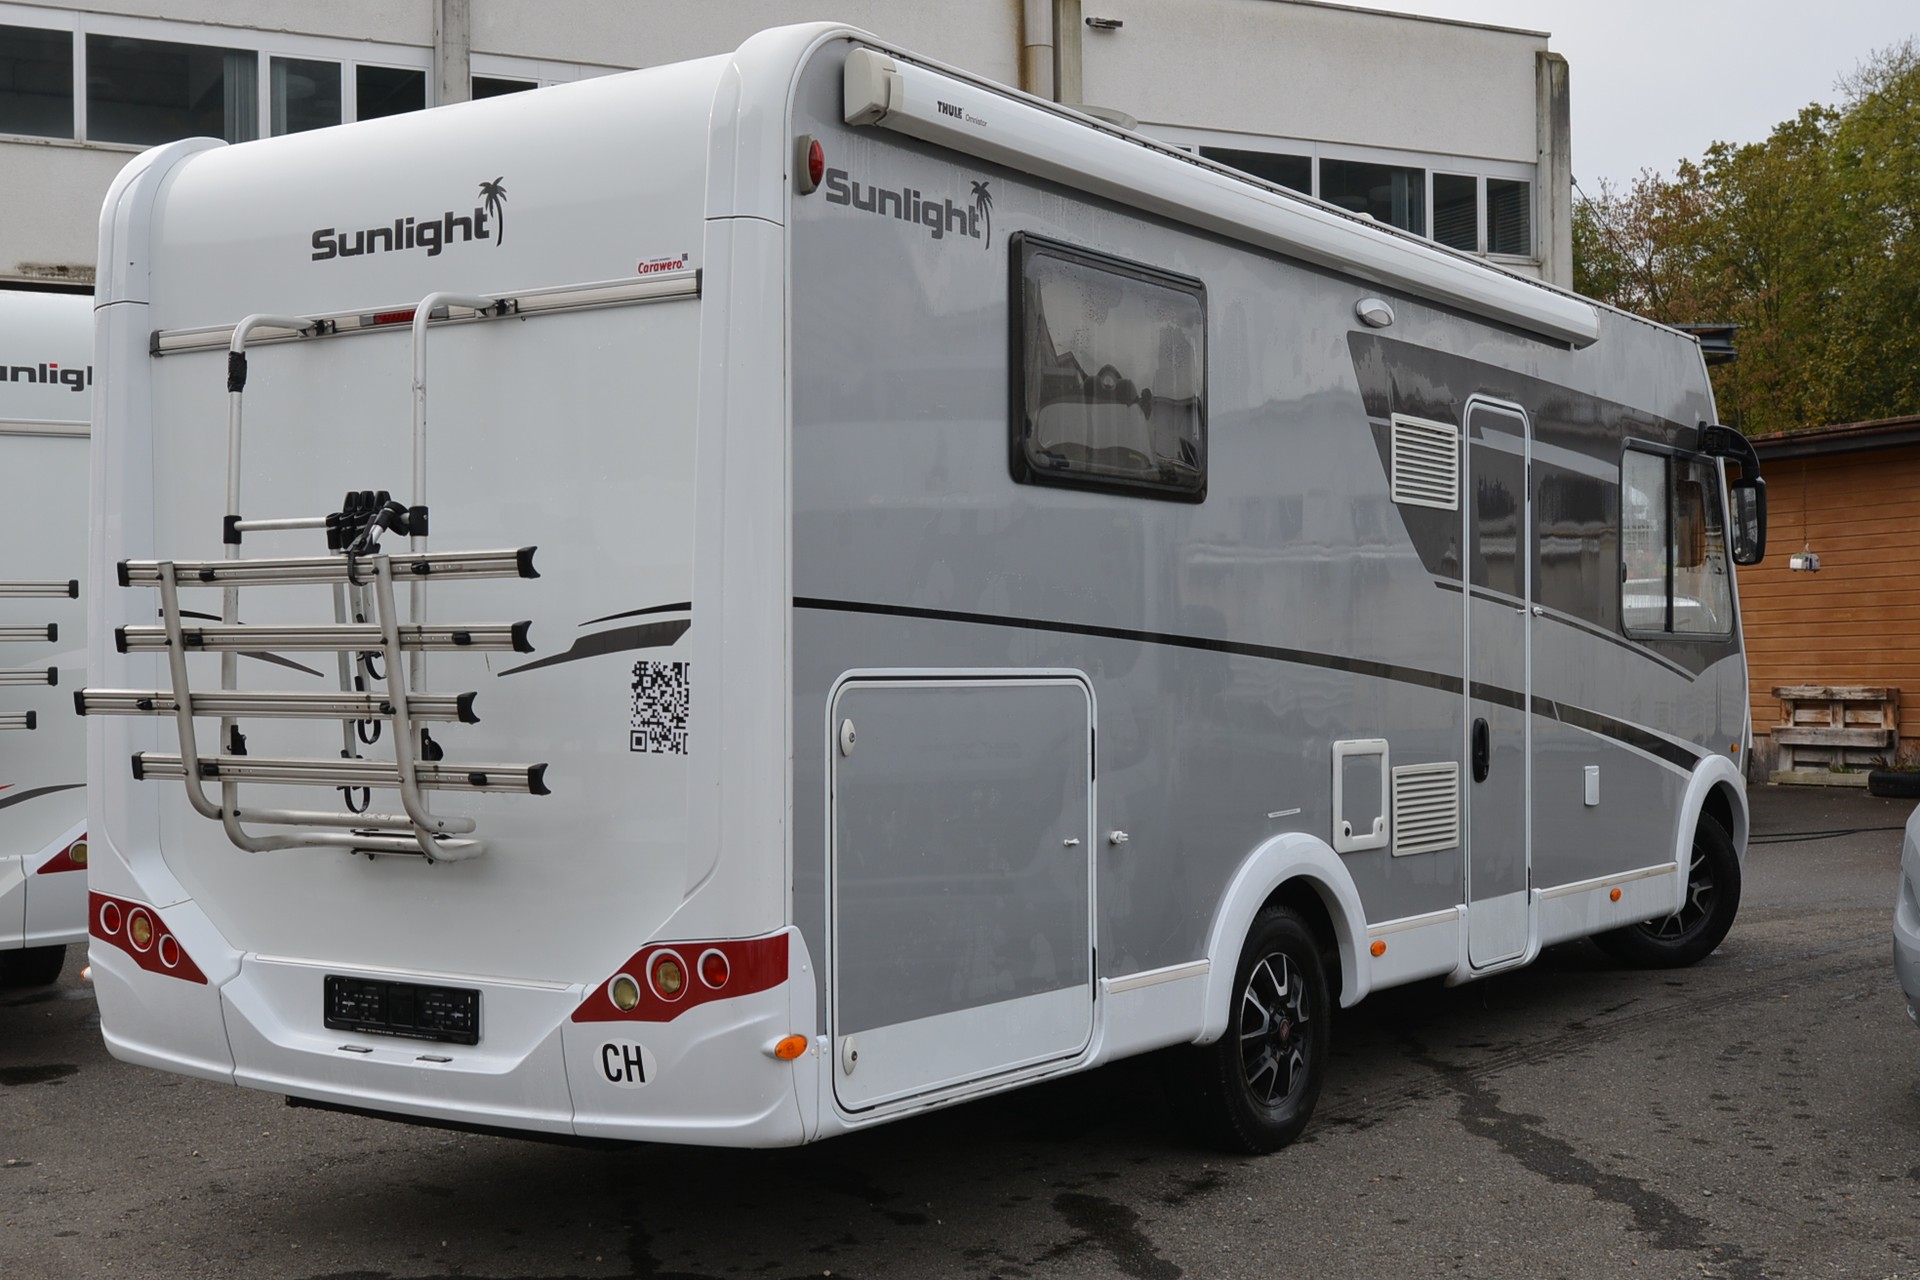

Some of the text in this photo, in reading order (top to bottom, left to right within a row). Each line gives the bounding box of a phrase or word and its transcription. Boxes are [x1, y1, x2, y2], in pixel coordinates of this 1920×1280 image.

[937, 100, 963, 117] THULE
[826, 167, 981, 240] Sunlight
[311, 207, 490, 261] Sunlight
[602, 1043, 645, 1083] CH
